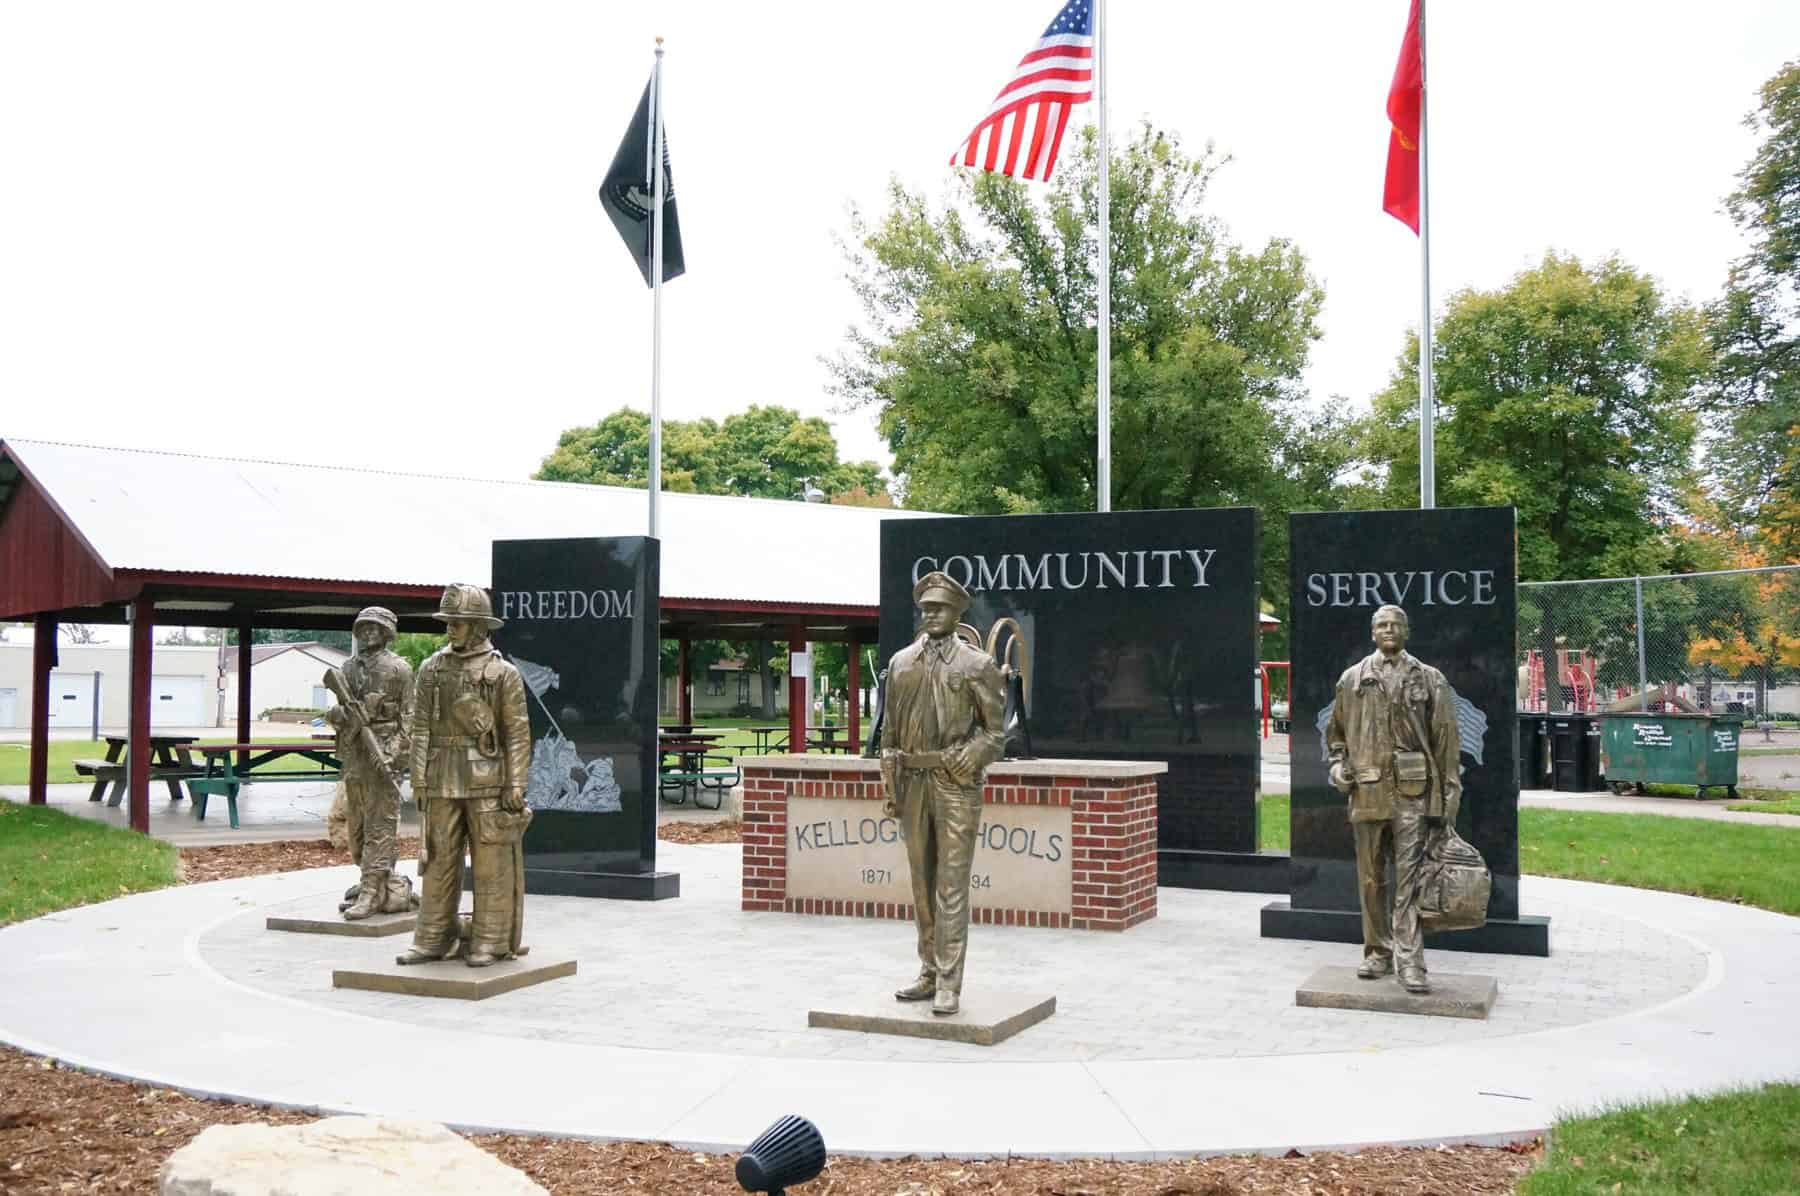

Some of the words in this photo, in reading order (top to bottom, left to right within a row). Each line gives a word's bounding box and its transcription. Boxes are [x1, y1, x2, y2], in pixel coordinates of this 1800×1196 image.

[911, 549, 1217, 591] COMMUNITY
[1306, 570, 1497, 607] SERVICE
[501, 590, 633, 620] FREEDOM
[795, 818, 904, 851] KELLOG
[976, 822, 1063, 862] HOOLS
[860, 868, 892, 885] 1871
